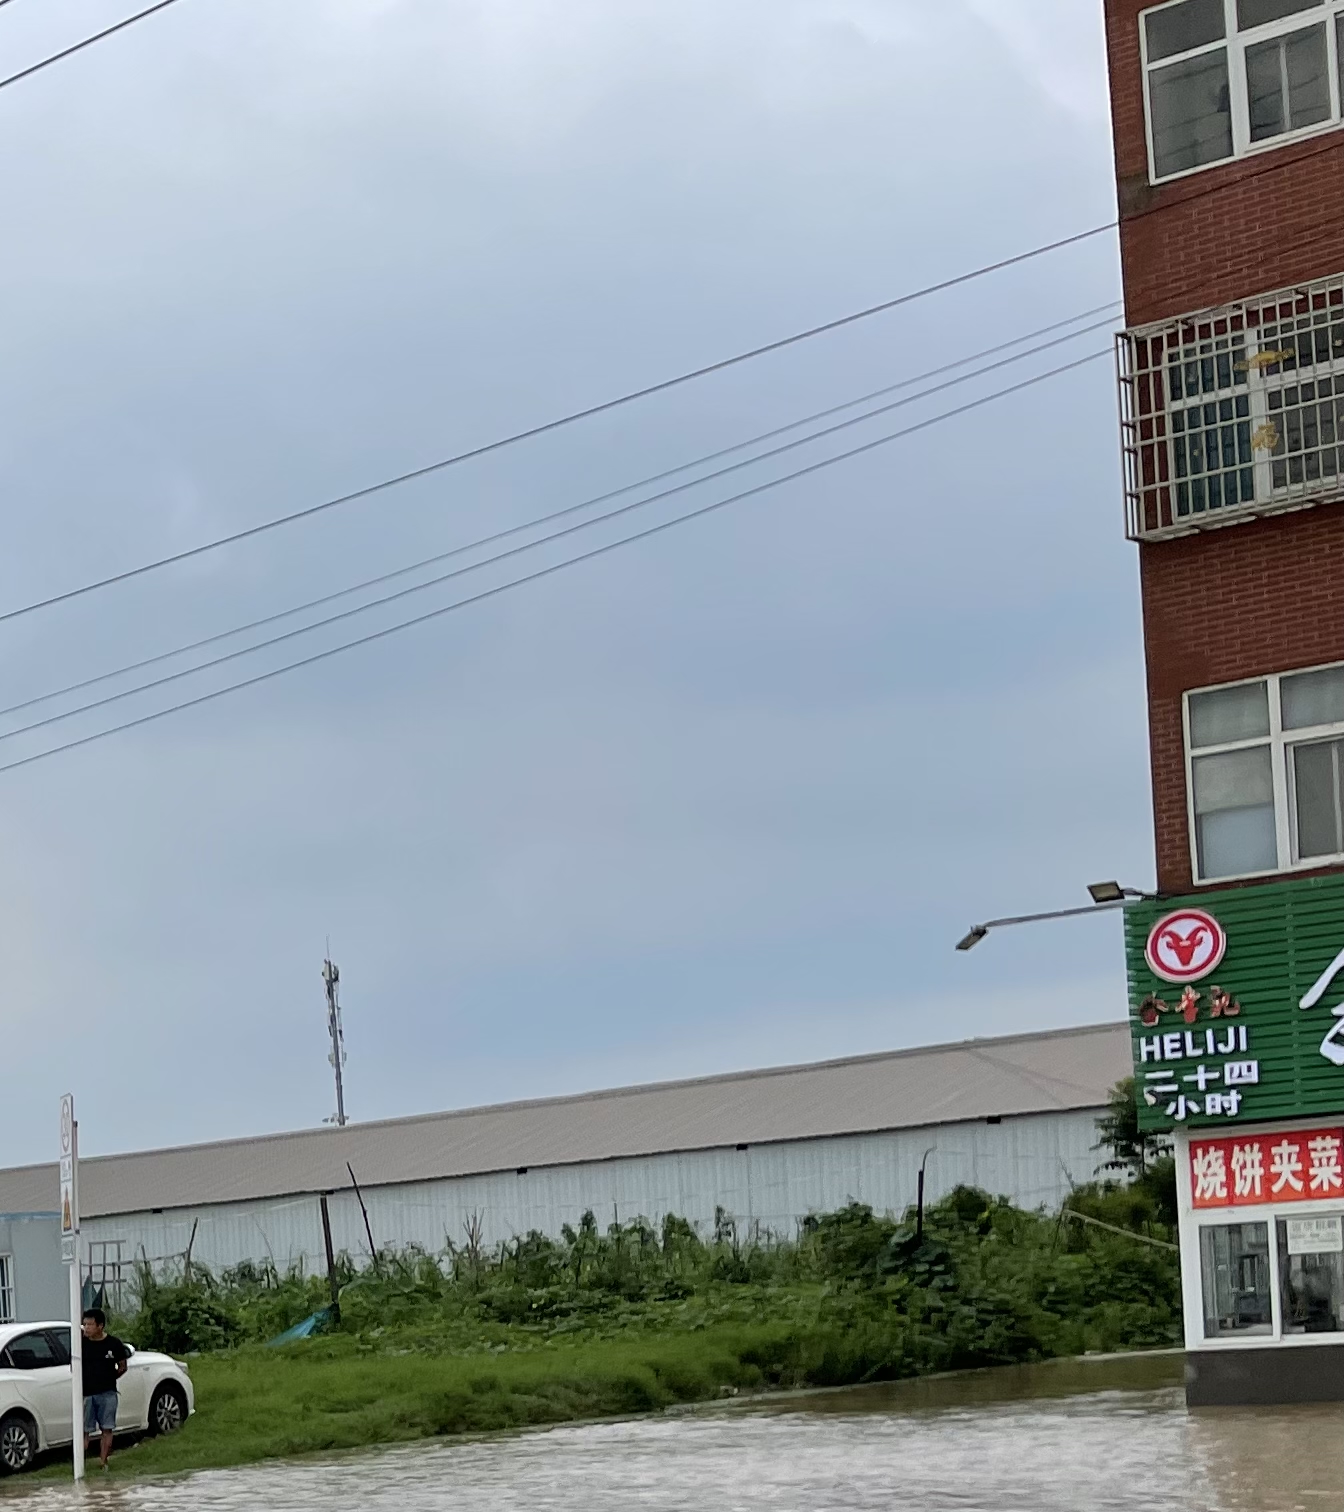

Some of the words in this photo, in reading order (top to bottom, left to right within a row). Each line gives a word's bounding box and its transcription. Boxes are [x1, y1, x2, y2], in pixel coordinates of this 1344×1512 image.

[1139, 1025, 1248, 1063] HELIJI
[1144, 1060, 1259, 1094] 二十四
[1164, 1088, 1243, 1122] 小时
[1192, 1135, 1343, 1201] 烧饼夹菜
